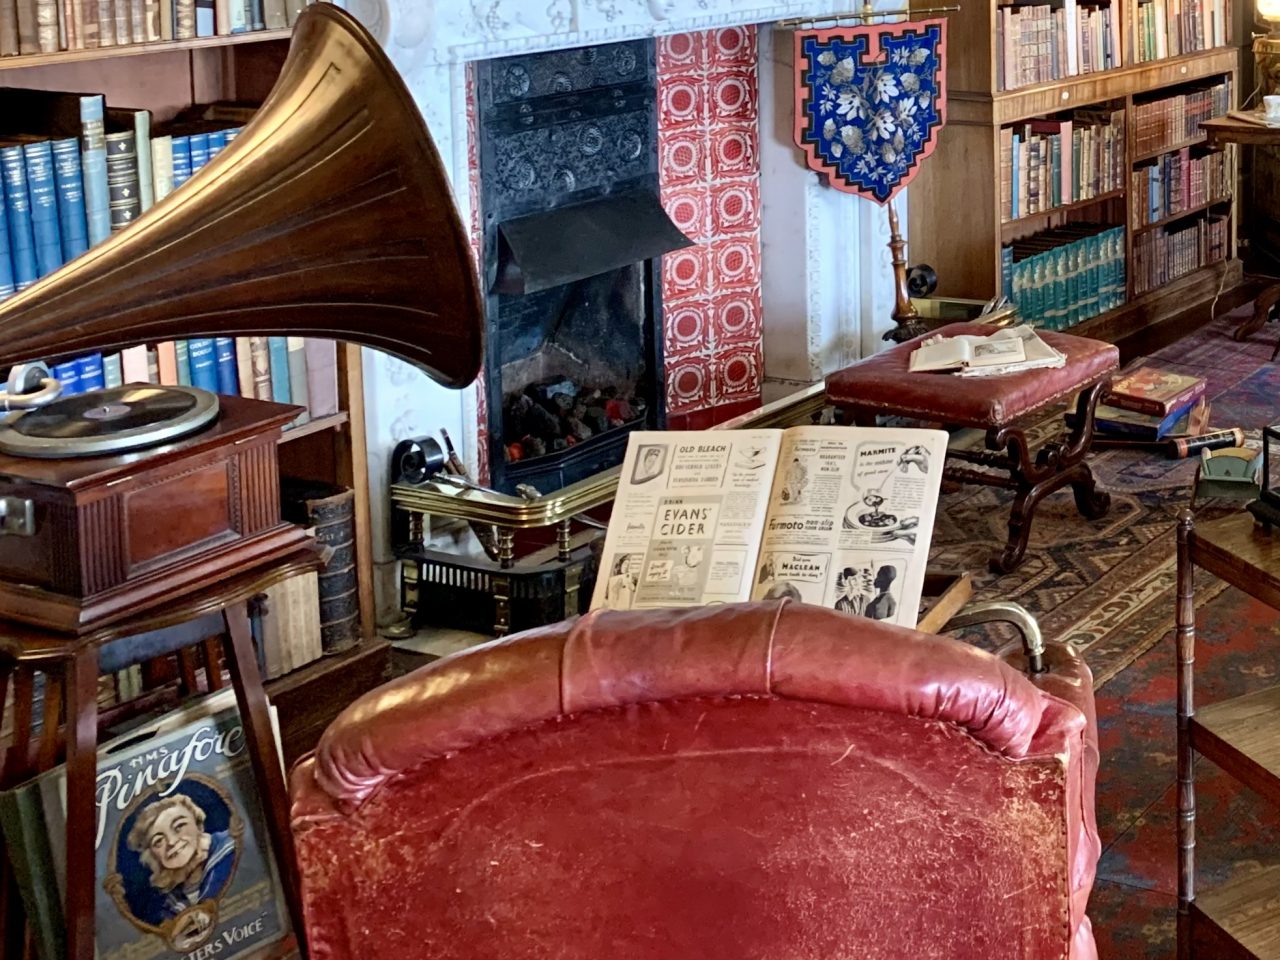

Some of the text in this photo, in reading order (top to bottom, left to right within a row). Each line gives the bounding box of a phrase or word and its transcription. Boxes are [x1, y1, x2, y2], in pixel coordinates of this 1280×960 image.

[679, 445, 727, 453] OLD BLEACH
[860, 447, 897, 457] MARMITE
[664, 507, 712, 521] EVANS'
[660, 523, 705, 536] CIDER
[782, 563, 820, 571] MACLEAN
[96, 726, 246, 850] Pinafore
